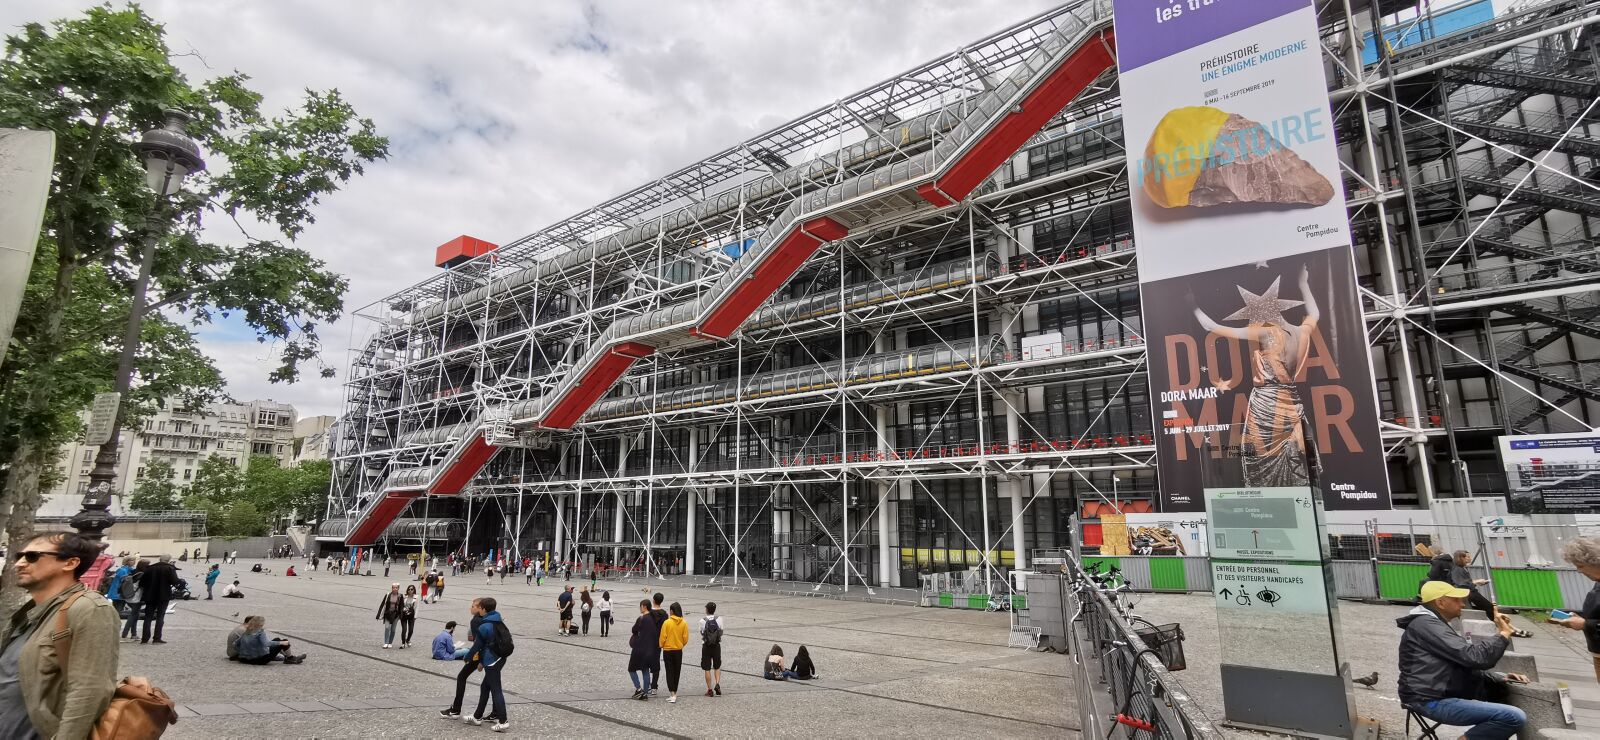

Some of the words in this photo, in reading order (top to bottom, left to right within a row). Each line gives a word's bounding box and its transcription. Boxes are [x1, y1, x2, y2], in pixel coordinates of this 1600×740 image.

[1156, 4, 1182, 23] les
[1200, 43, 1260, 72] PRÉHISTOIRE
[1201, 68, 1220, 83] UNE
[1222, 56, 1258, 76] ÉNIGME
[1259, 40, 1308, 64] MODERNE
[1230, 83, 1260, 98] SEPTEMBRE
[1262, 79, 1275, 88] 2019
[1136, 107, 1326, 188] PRÉHISTOIRE
[1297, 223, 1319, 232] Centre
[1306, 227, 1339, 238] Pompidou
[1160, 390, 1187, 403] DORA
[1188, 386, 1218, 400] MAAR
[1216, 423, 1230, 431] 2019
[1330, 482, 1355, 491] Centre
[1341, 490, 1378, 501] Pompidou
[1246, 566, 1280, 574] PERSONNEL
[1237, 574, 1265, 582] VISITEURS
[1266, 576, 1304, 584] HANDICAPÉS
